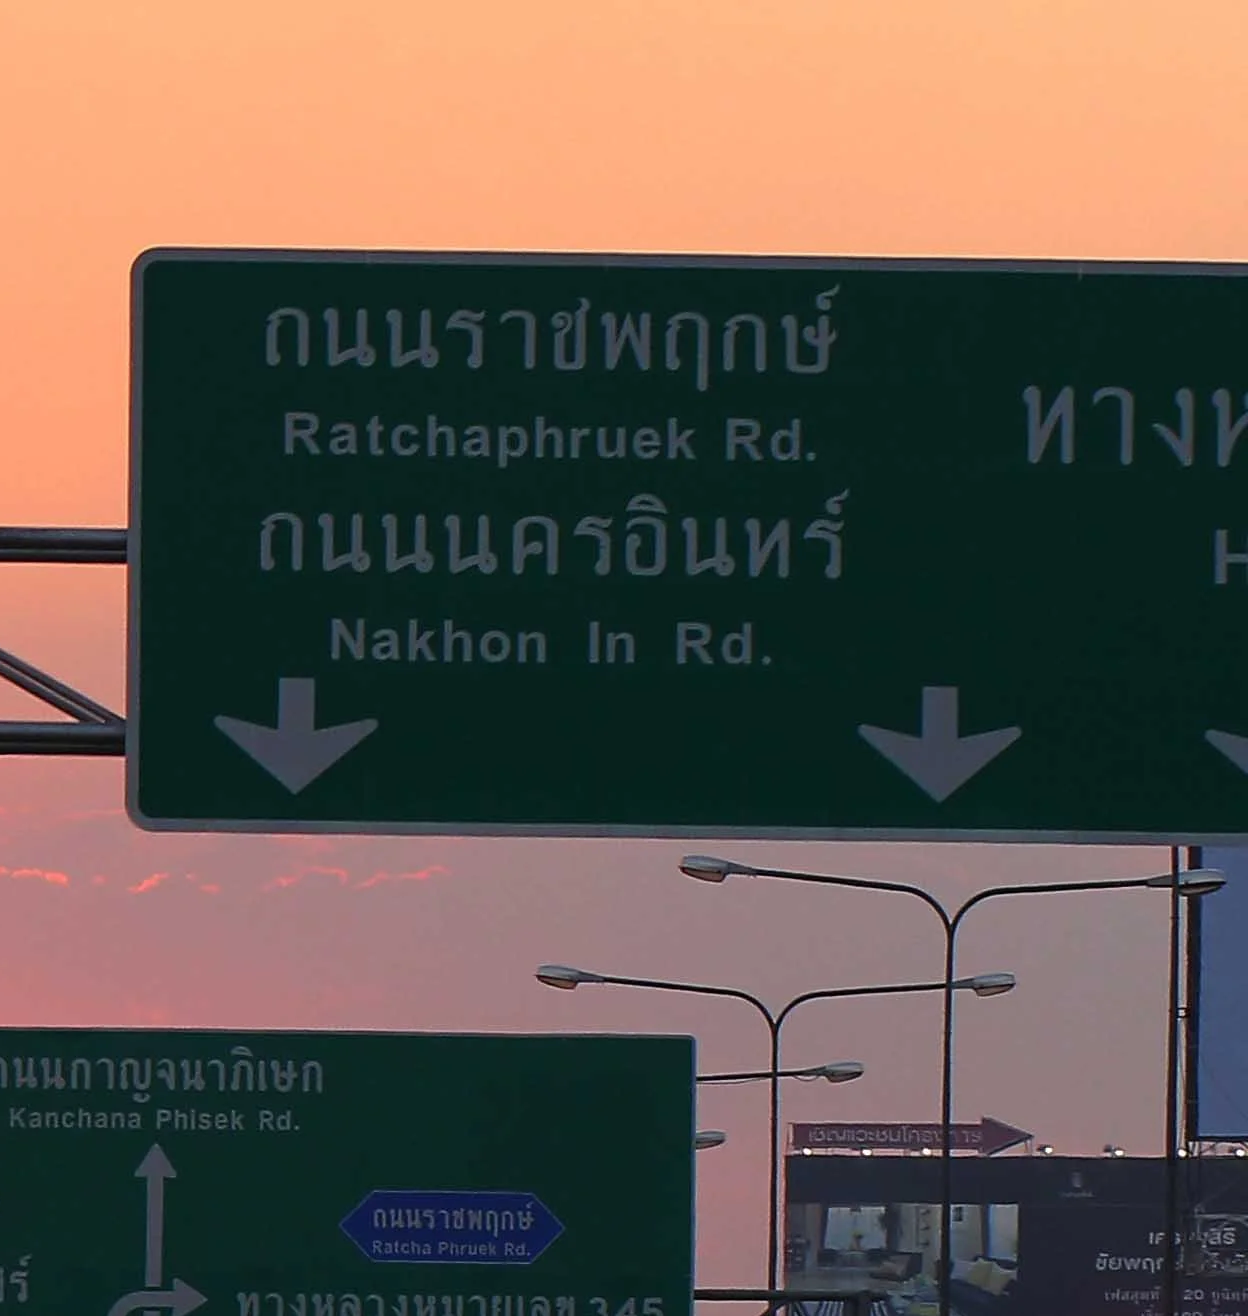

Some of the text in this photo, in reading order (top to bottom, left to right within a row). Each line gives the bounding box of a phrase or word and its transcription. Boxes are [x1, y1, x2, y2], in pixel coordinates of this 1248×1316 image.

[265, 284, 840, 392] ถนนราชพฤกษ์
[284, 411, 817, 468] Ratchaphruek Rd.
[260, 488, 849, 579] ถนนนครอินทร์
[330, 618, 773, 666] Nakhon In Rd.
[9, 1107, 300, 1131] Kanchana Phisek Rd.
[372, 1201, 536, 1238] ถนนราชพฤกษ์
[372, 1240, 532, 1258] Ratcha Phruek Rd.
